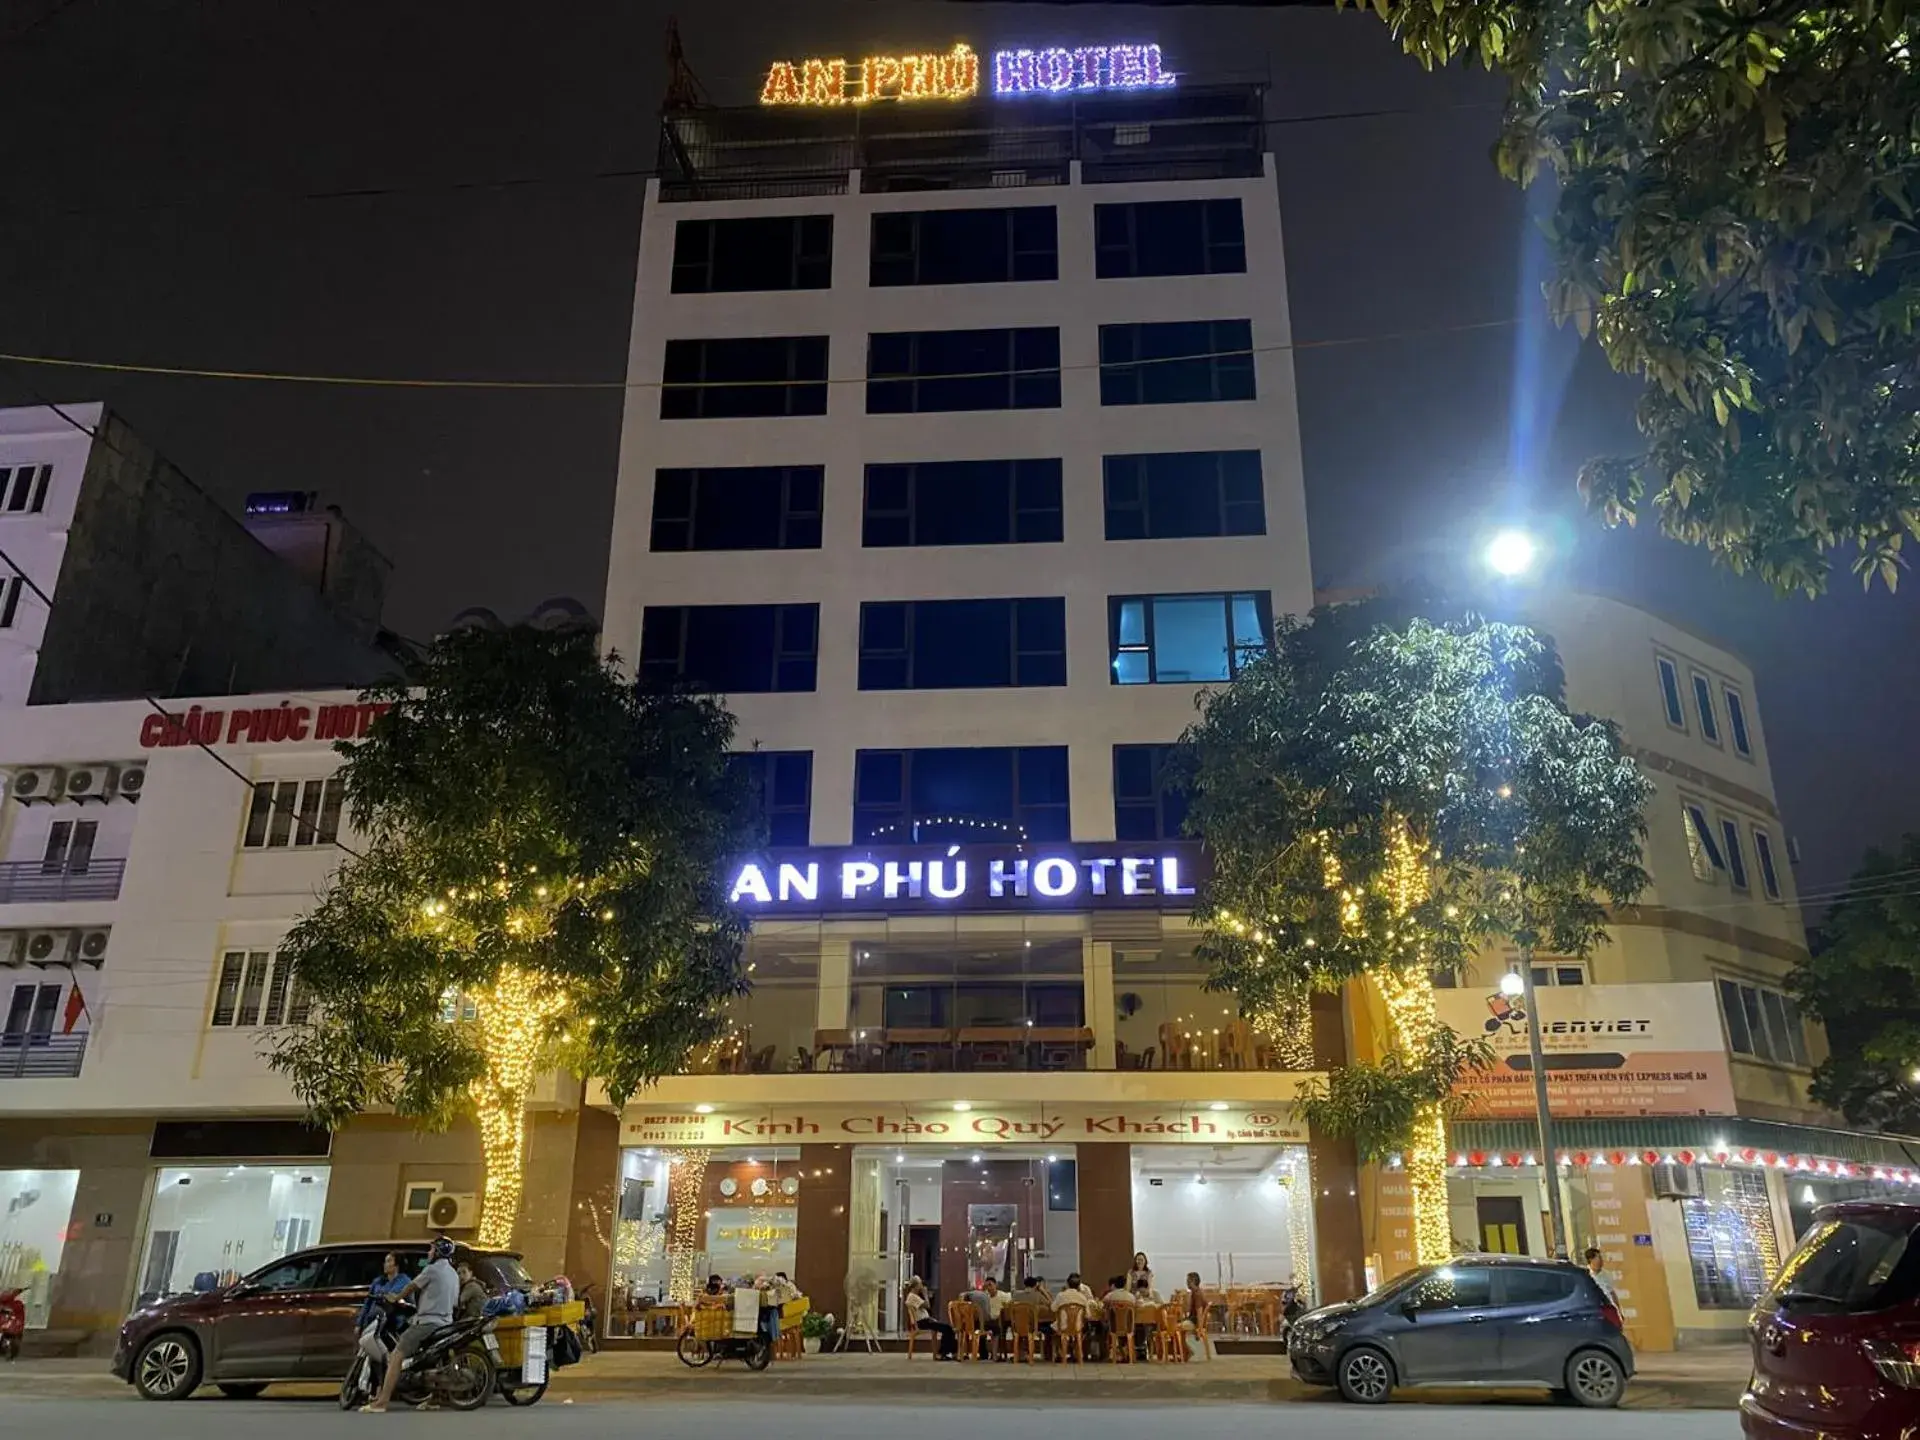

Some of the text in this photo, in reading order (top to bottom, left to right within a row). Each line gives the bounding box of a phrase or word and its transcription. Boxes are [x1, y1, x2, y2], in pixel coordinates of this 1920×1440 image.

[760, 60, 846, 104] AN
[994, 43, 1177, 93] HOTEL
[139, 705, 225, 747] CHÂU
[226, 701, 311, 744] PHÚC
[731, 845, 1196, 902] AN PHÚ HOTEL
[1636, 1072, 1671, 1081] EXPRESS
[724, 1115, 1216, 1139] Kính Chào Quý Khách
